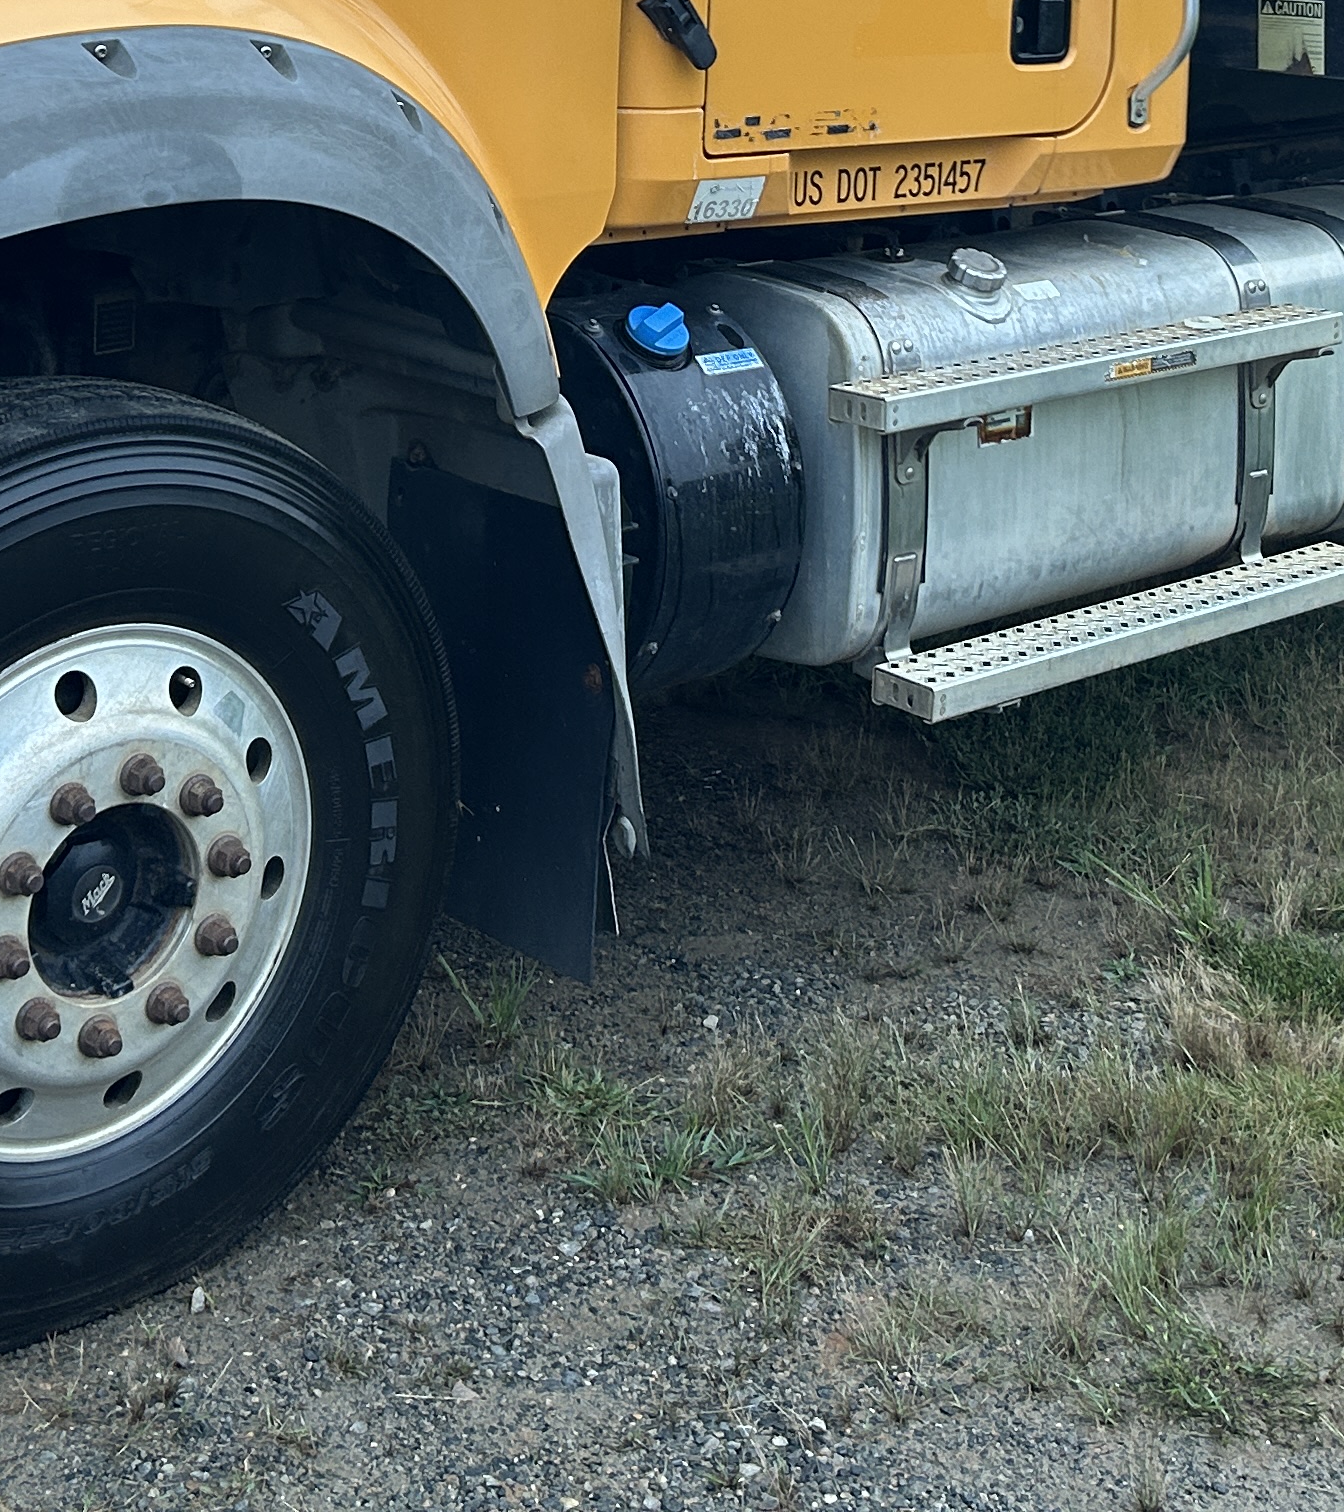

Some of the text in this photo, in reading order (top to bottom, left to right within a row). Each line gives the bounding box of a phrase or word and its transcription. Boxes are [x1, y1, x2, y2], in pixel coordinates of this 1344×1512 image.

[1274, 0, 1322, 18] CAUTION
[793, 158, 987, 207] US DOT 2351457
[81, 872, 116, 916] Mack
